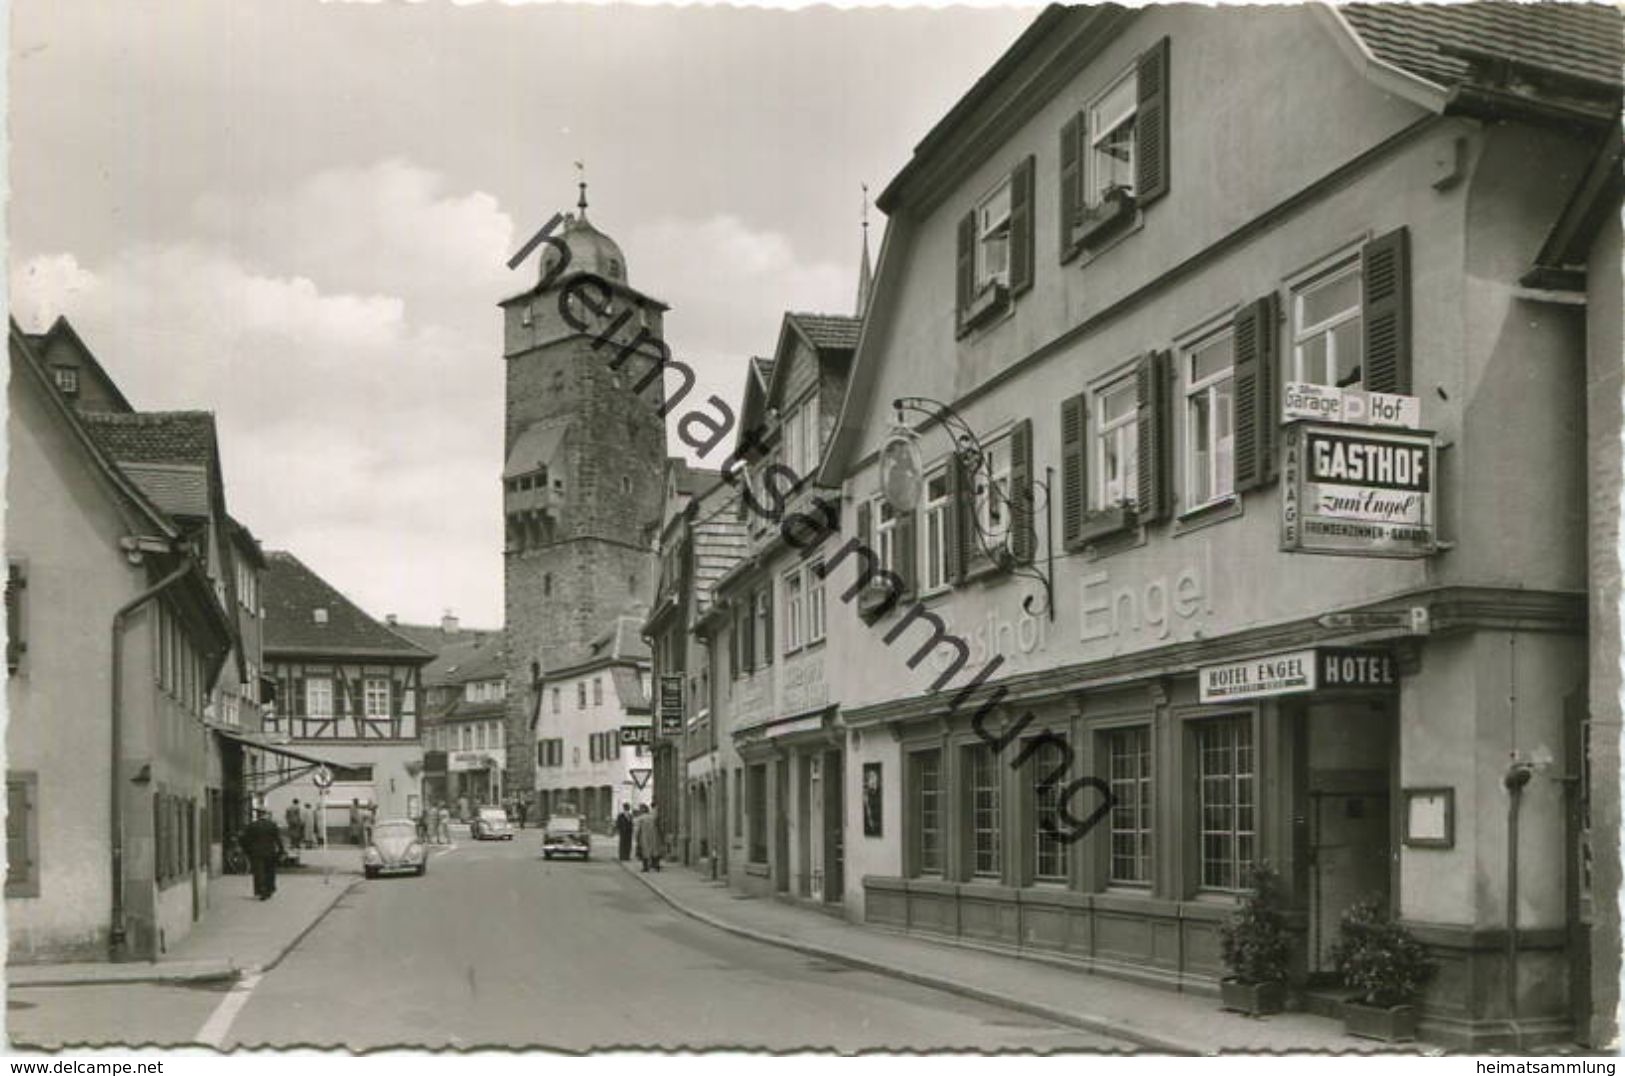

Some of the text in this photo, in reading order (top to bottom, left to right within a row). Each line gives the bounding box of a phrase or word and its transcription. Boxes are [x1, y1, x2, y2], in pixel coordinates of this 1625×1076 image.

[1286, 386, 1339, 417] Garage
[1372, 397, 1402, 421] Hof
[1313, 439, 1424, 486] GASTHOF
[1359, 490, 1415, 517] Engel
[1080, 538, 1212, 642] Engel
[1410, 606, 1429, 632] P
[1209, 667, 1248, 688] HOTEL
[1257, 659, 1305, 681] ENGEL
[1325, 656, 1394, 684] HOTEL
